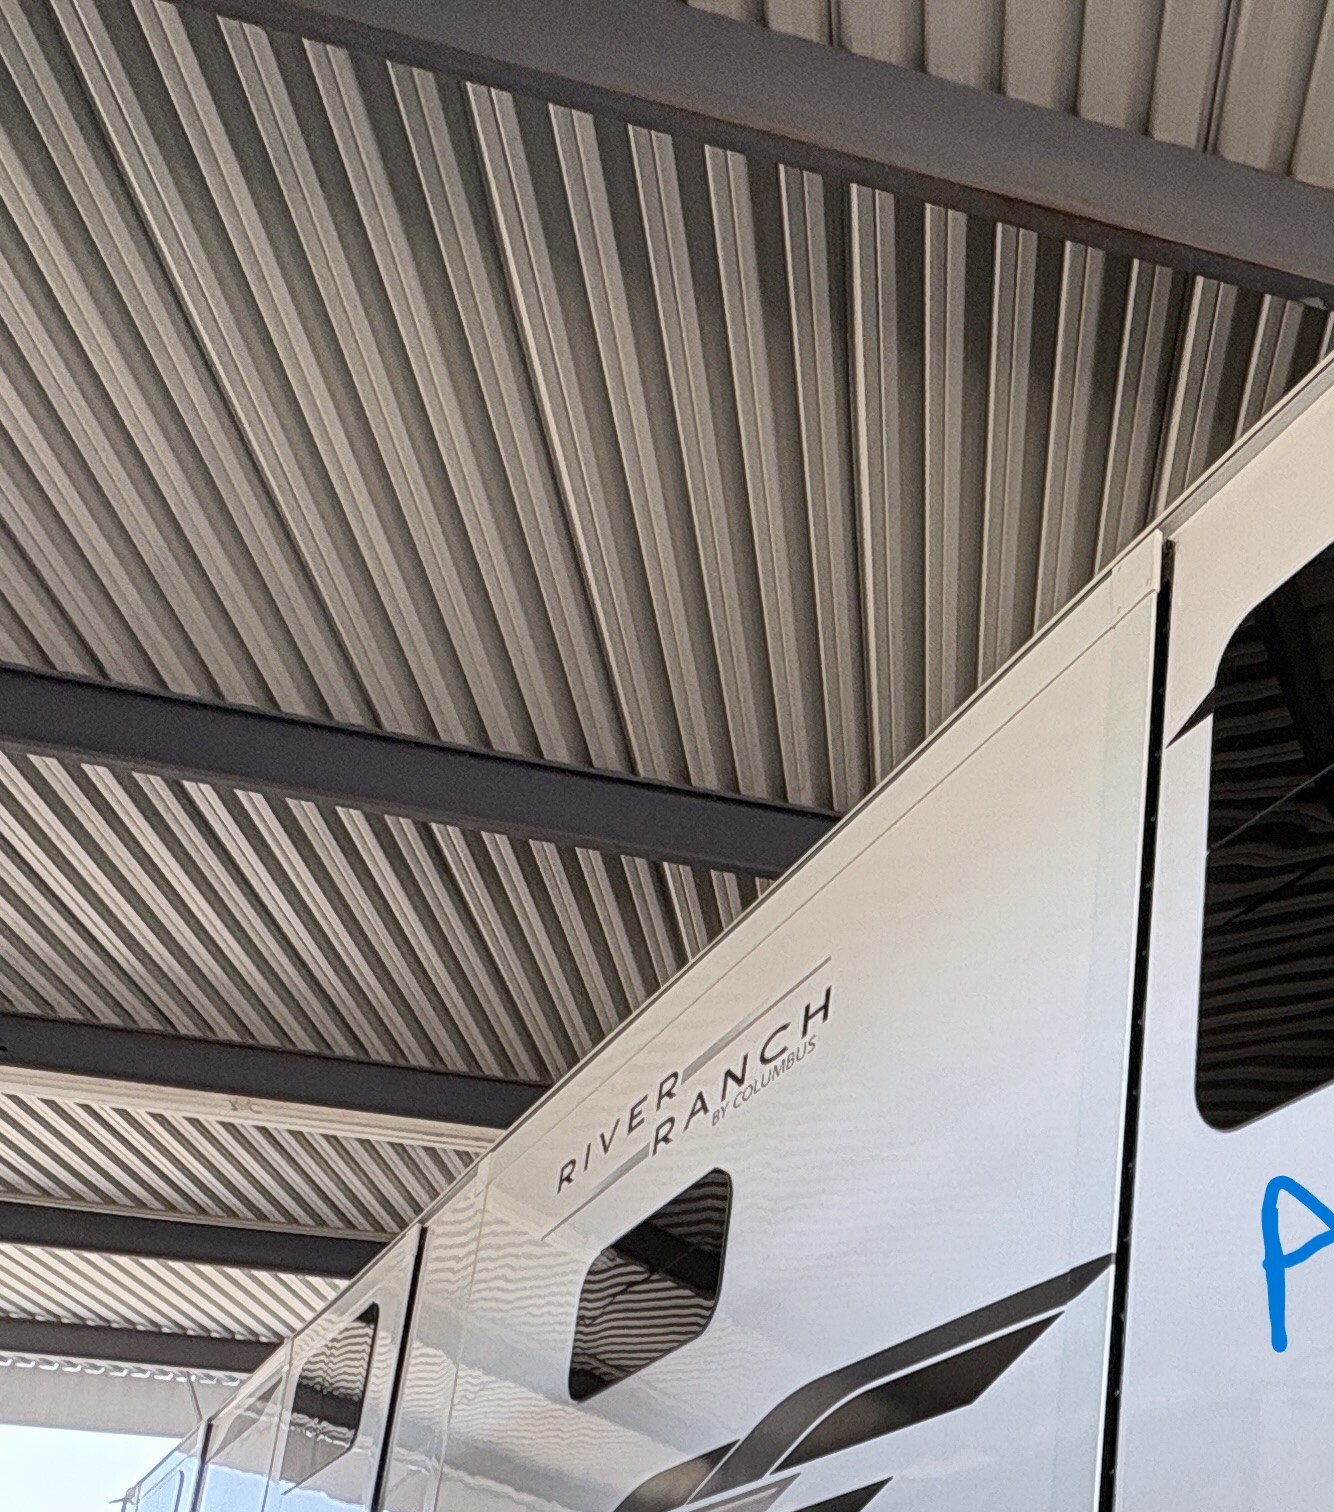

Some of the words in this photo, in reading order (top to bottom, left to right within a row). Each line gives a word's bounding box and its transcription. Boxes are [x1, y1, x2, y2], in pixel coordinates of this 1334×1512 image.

[556, 1070, 680, 1194] RIVER
[651, 984, 833, 1156] RANCH
[711, 1101, 729, 1127] BY
[732, 1034, 818, 1110] COLUMBUS
